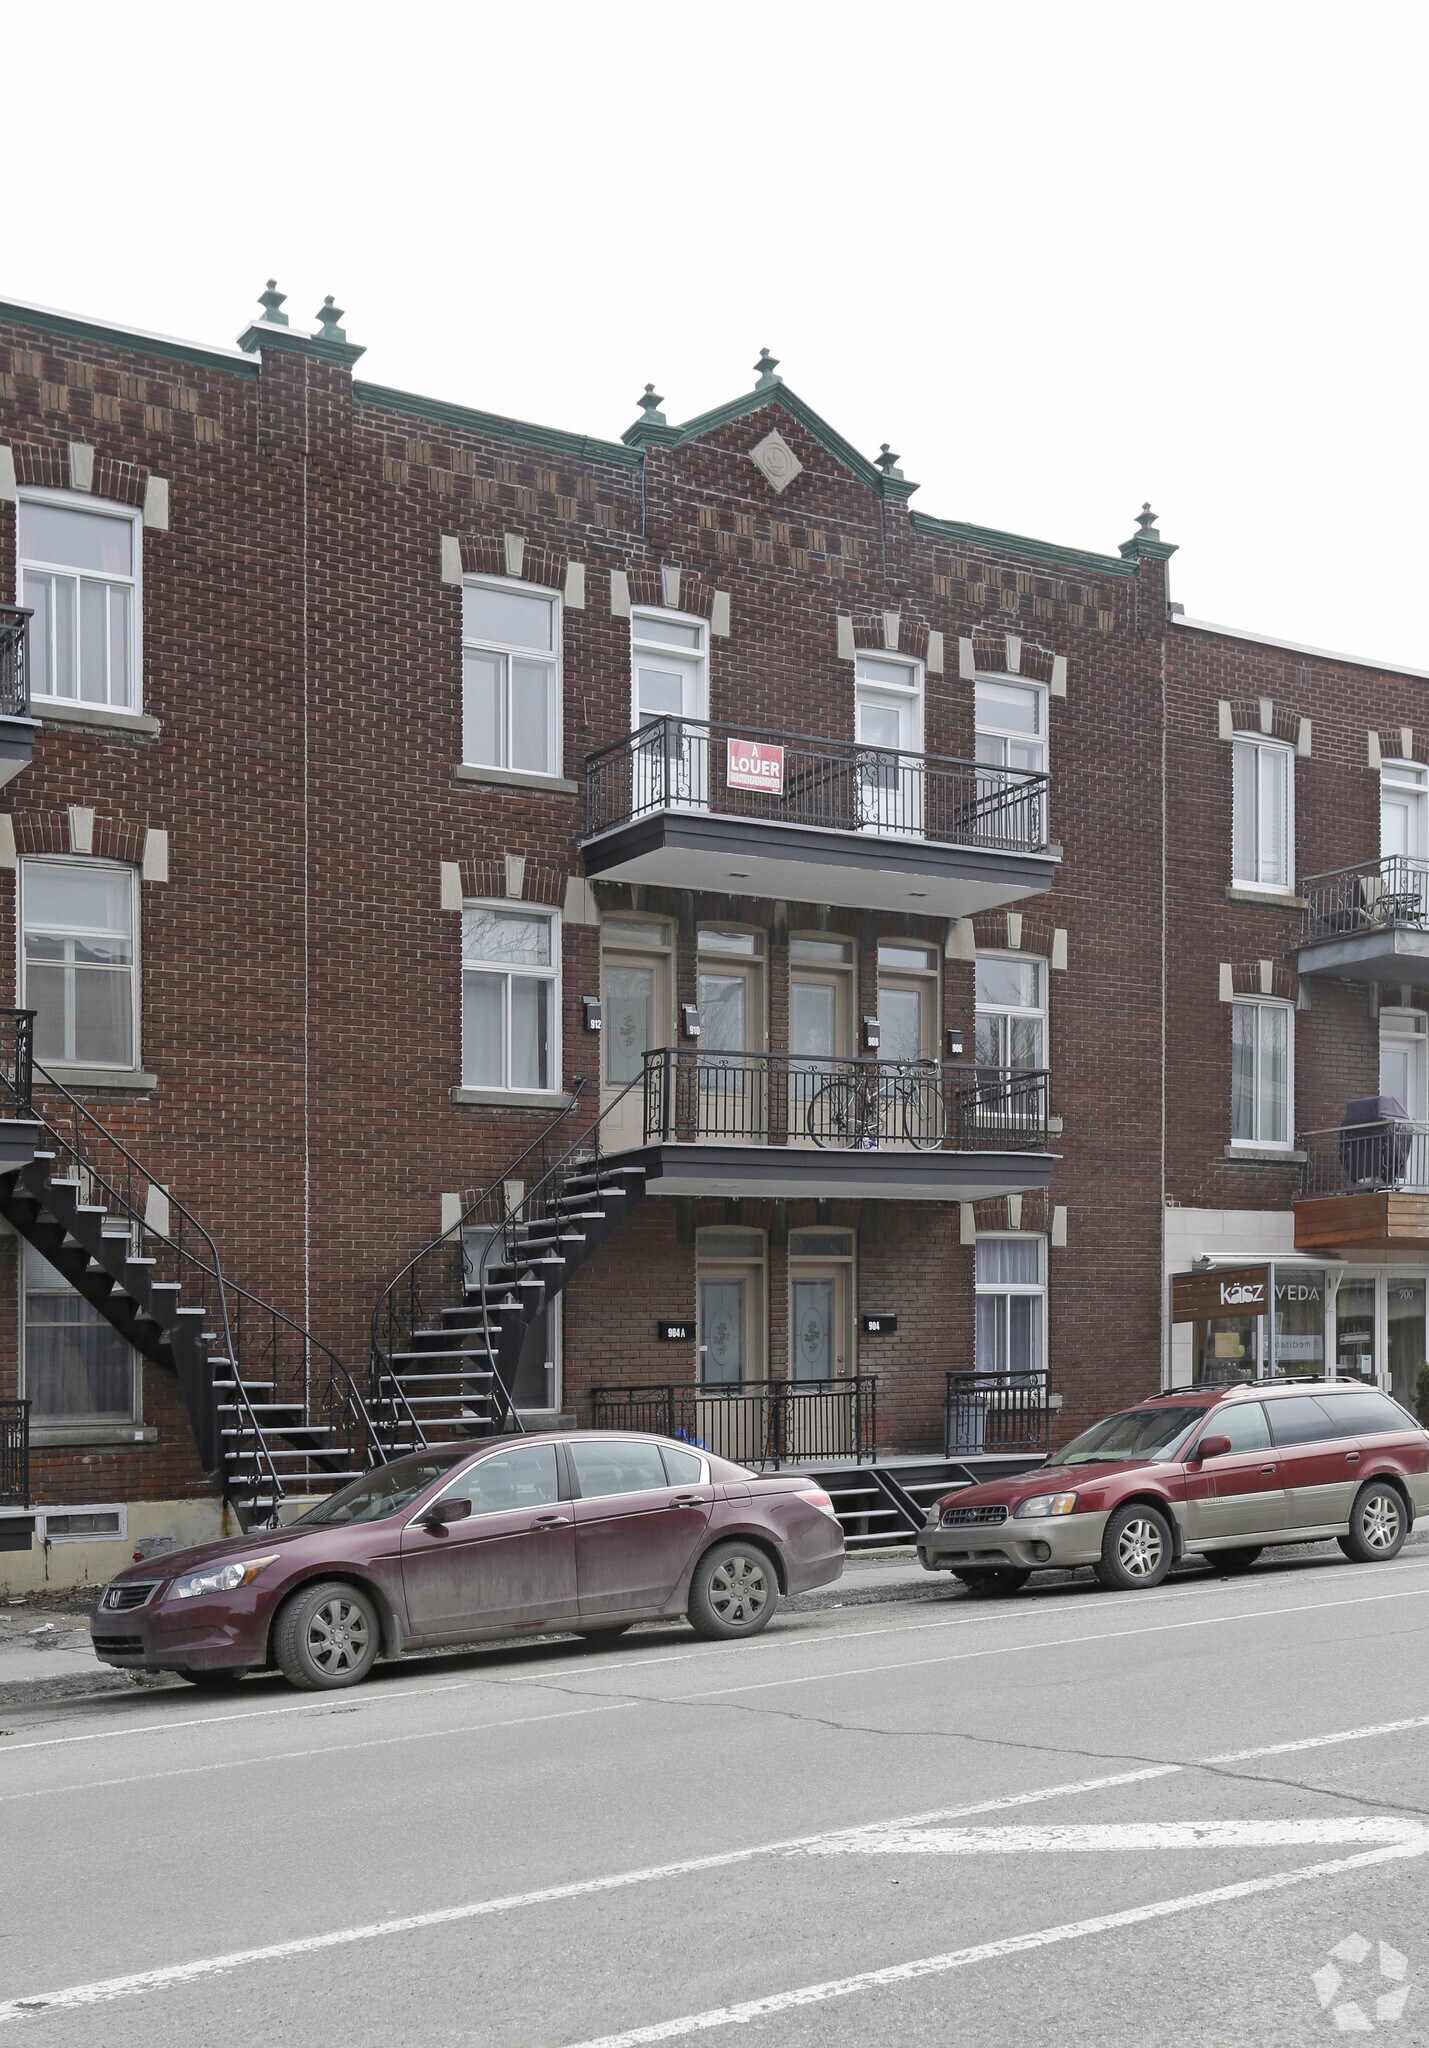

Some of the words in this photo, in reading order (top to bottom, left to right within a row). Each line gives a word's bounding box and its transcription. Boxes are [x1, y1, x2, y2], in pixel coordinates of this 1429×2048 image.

[751, 744, 759, 758] À
[731, 755, 780, 778] LOUER
[590, 1019, 602, 1029] 912
[689, 1025, 701, 1035] 910
[1400, 1288, 1414, 1300] 900
[868, 1321, 880, 1331] 904
